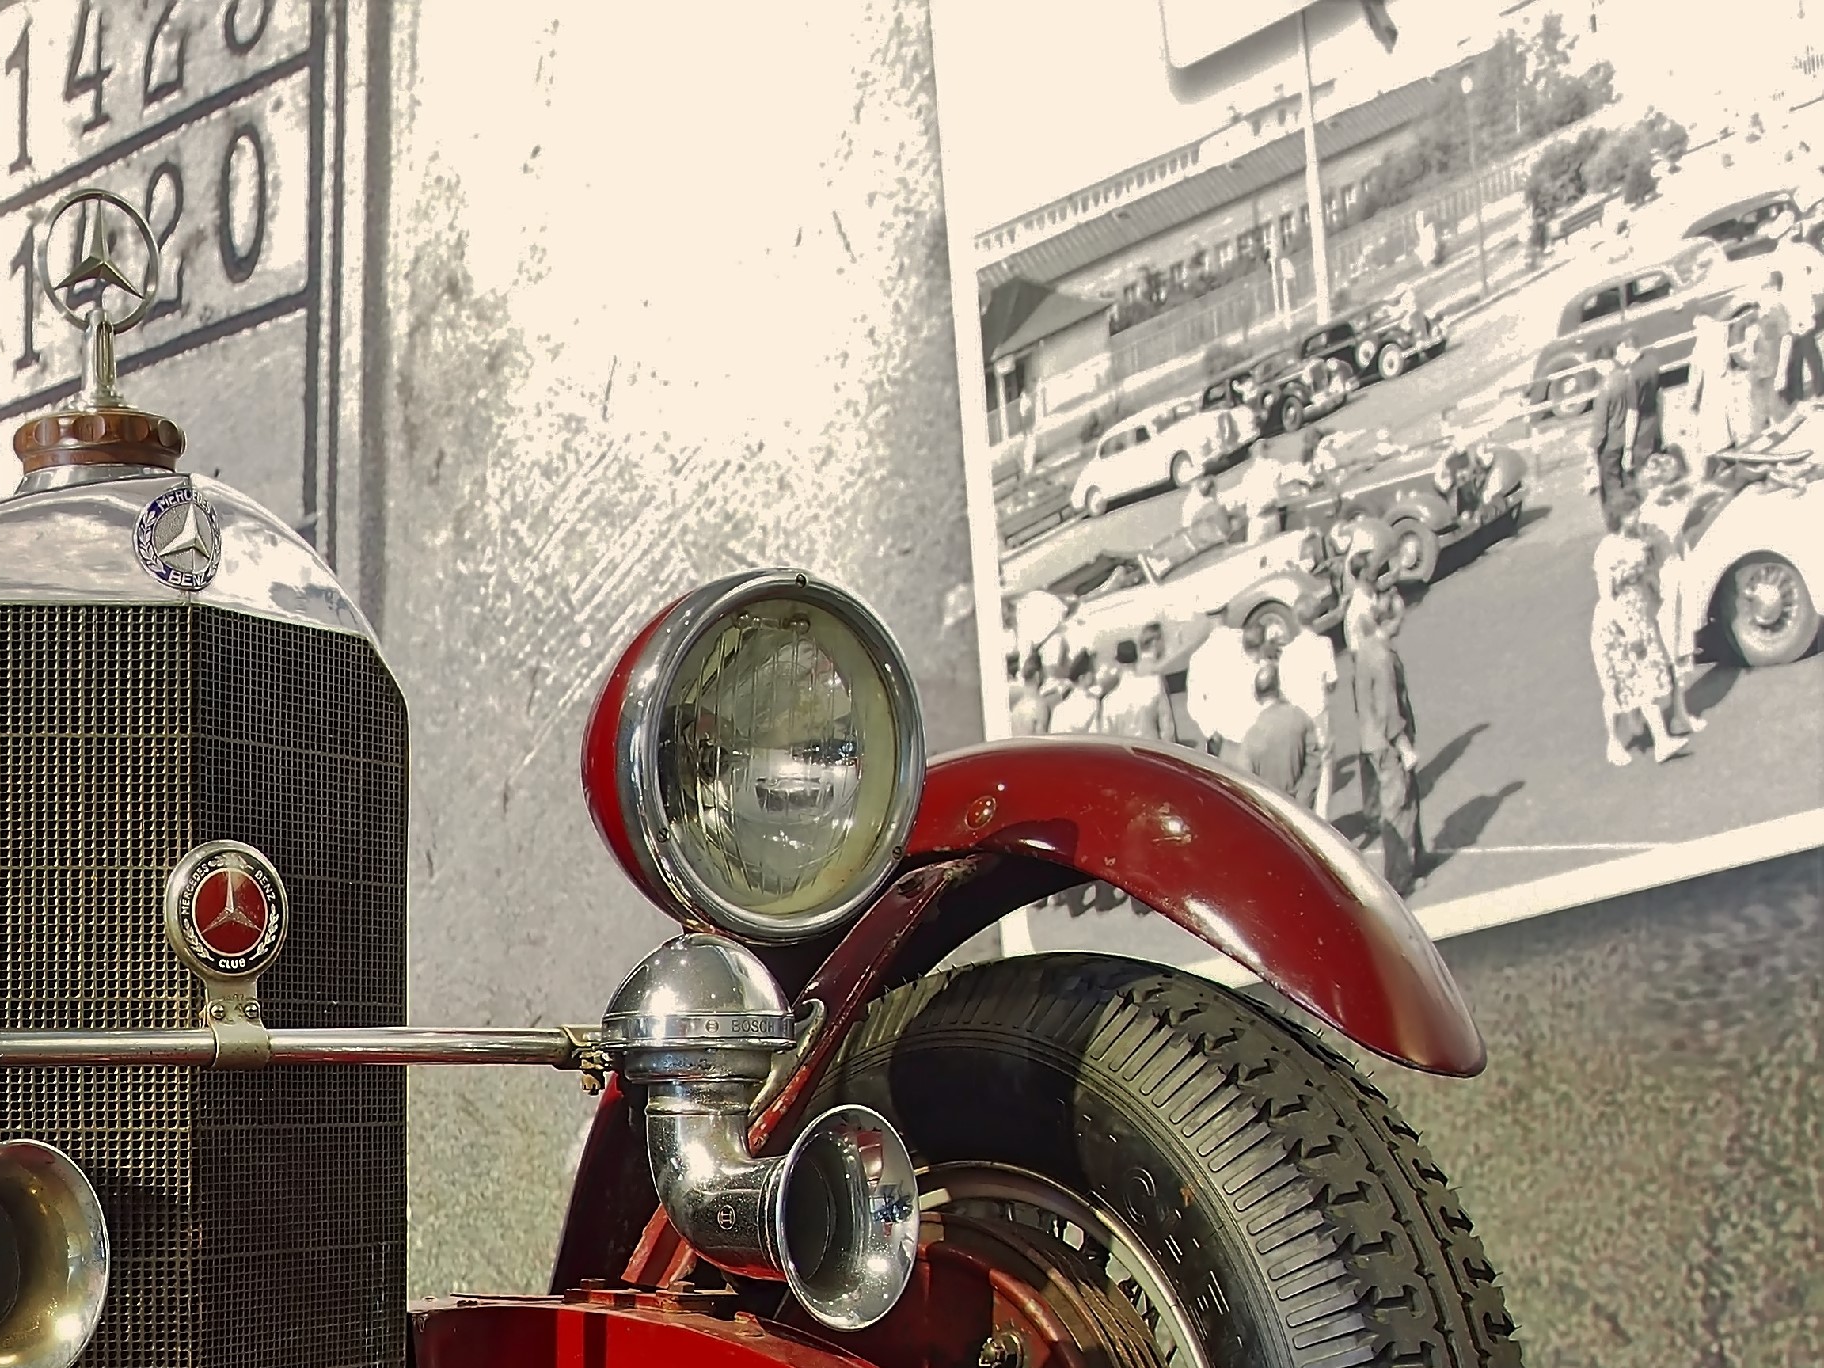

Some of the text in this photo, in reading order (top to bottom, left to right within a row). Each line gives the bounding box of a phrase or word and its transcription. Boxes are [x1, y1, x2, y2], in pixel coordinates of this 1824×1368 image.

[155, 488, 211, 515] MERCEDES
[168, 569, 208, 587] BENZ
[181, 864, 277, 916] MERCEDES BENZ
[218, 957, 247, 969] CLUB
